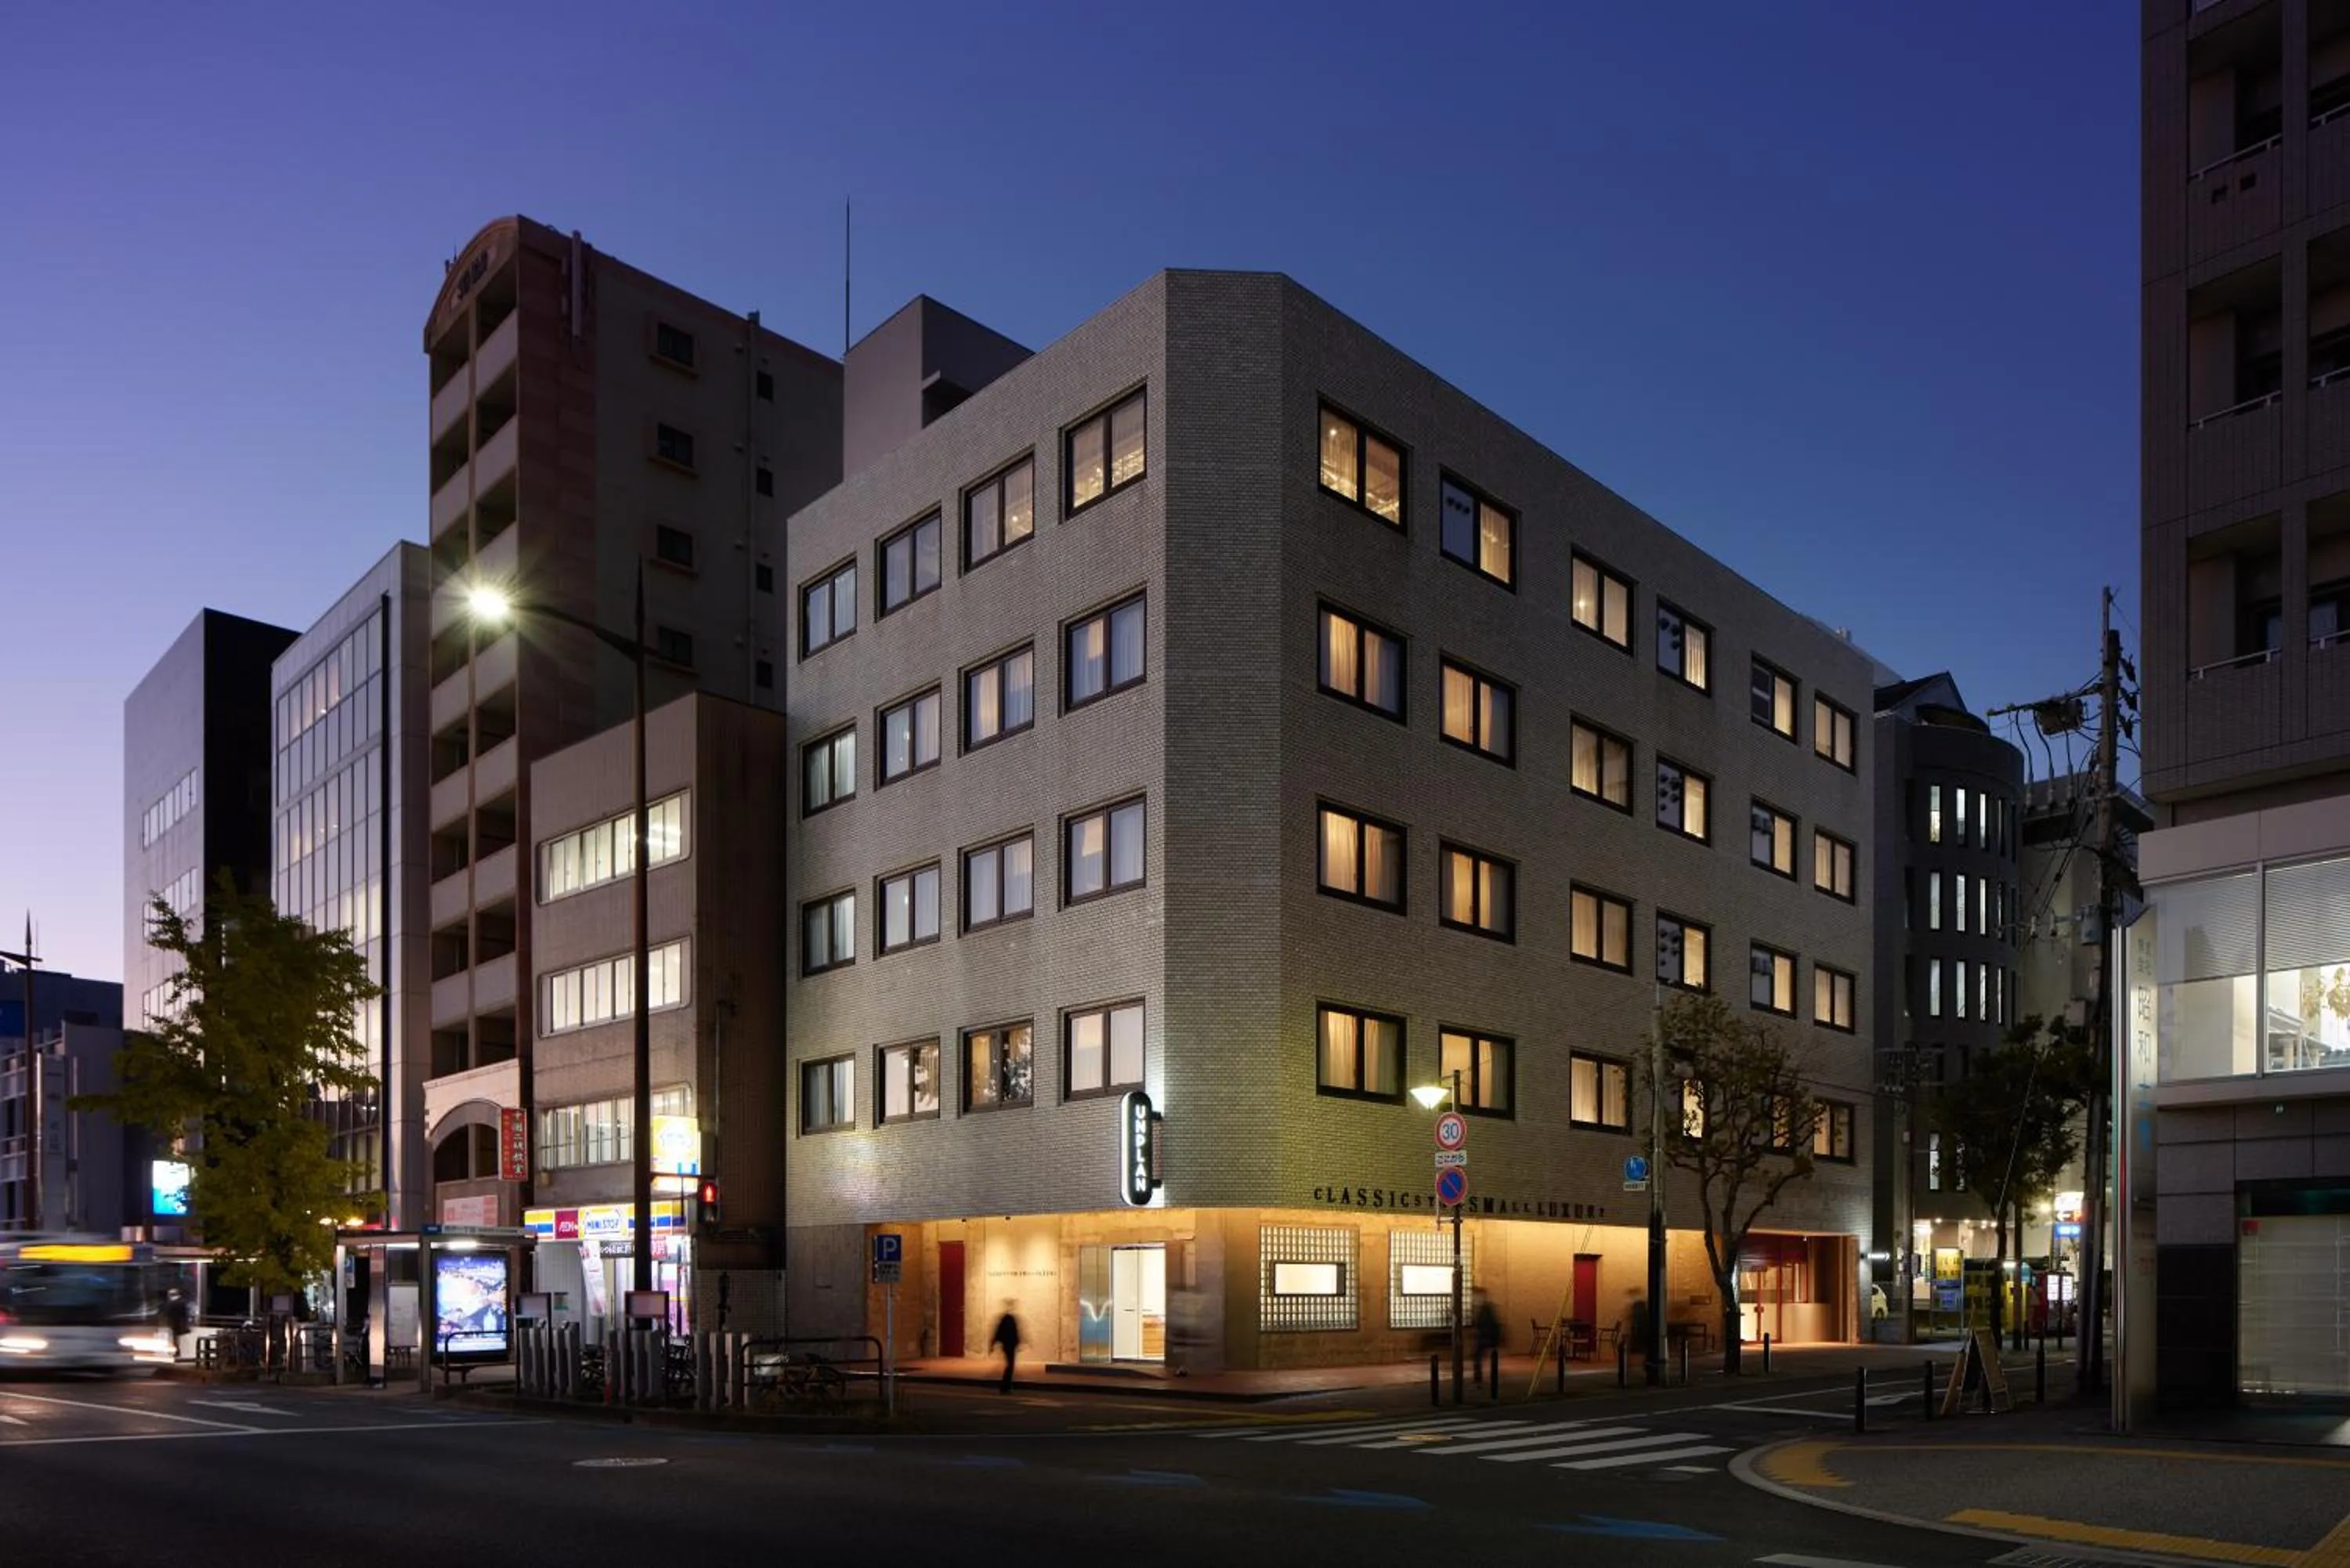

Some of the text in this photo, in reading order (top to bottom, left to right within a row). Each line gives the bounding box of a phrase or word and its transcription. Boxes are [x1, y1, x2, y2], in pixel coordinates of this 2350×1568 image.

[1442, 1124, 1459, 1140] 30
[1135, 1105, 1147, 1192] UNPLAN
[883, 1237, 898, 1259] P
